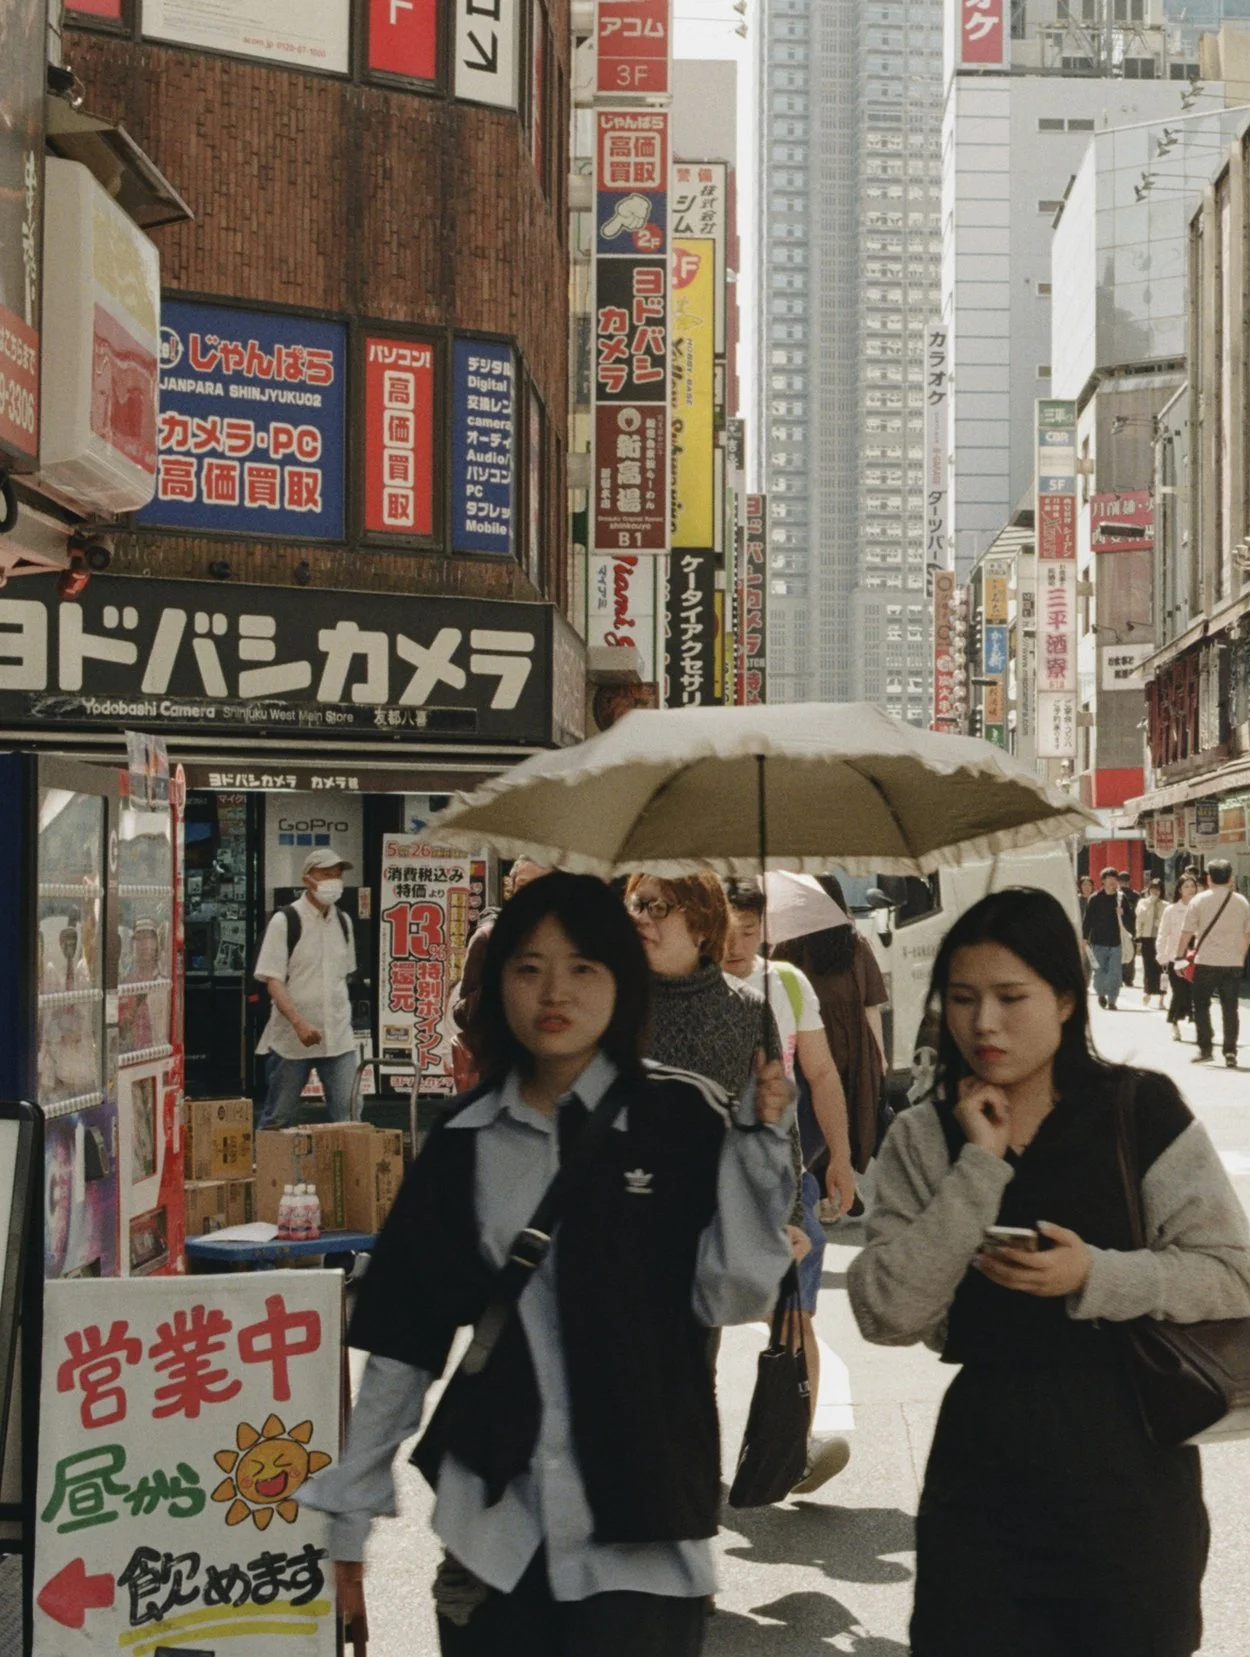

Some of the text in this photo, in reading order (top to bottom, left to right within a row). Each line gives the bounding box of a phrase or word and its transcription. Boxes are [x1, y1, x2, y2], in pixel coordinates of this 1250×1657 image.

[600, 17, 665, 38] アコム
[616, 64, 648, 87] 3F
[600, 114, 664, 131] じゃんぱら
[636, 229, 661, 249] 2F
[632, 266, 665, 385] ヨドバシ
[188, 333, 334, 387] じゃんぱら
[368, 344, 431, 369] パソコン!
[599, 306, 629, 393] カメラ
[467, 375, 508, 393] Digital
[928, 331, 946, 406] カラオケ
[159, 376, 322, 407] JANPARA SHINJYUKU02
[158, 411, 322, 462] カメラ・PC
[384, 371, 414, 526] 高価買取
[466, 449, 513, 466] Audio/
[157, 455, 323, 513] 高価買取
[466, 484, 484, 497] PC
[466, 519, 508, 536] Mobile
[928, 489, 946, 561] ダーツバー
[0, 600, 535, 709] ヨドバシカメラ
[84, 698, 353, 723] Yodobashi Camera Shinjuku West Main Store
[208, 772, 297, 788] ヨドバシカメラ
[278, 818, 349, 832] GoPro
[387, 867, 464, 883] 消費税込み
[395, 883, 445, 898] 特価より
[389, 960, 416, 1013] 還元
[416, 960, 443, 1070] 特別ポイント
[57, 1294, 321, 1429] 営業中
[41, 1443, 206, 1533] 昼から
[117, 1543, 329, 1626] 飲めます
